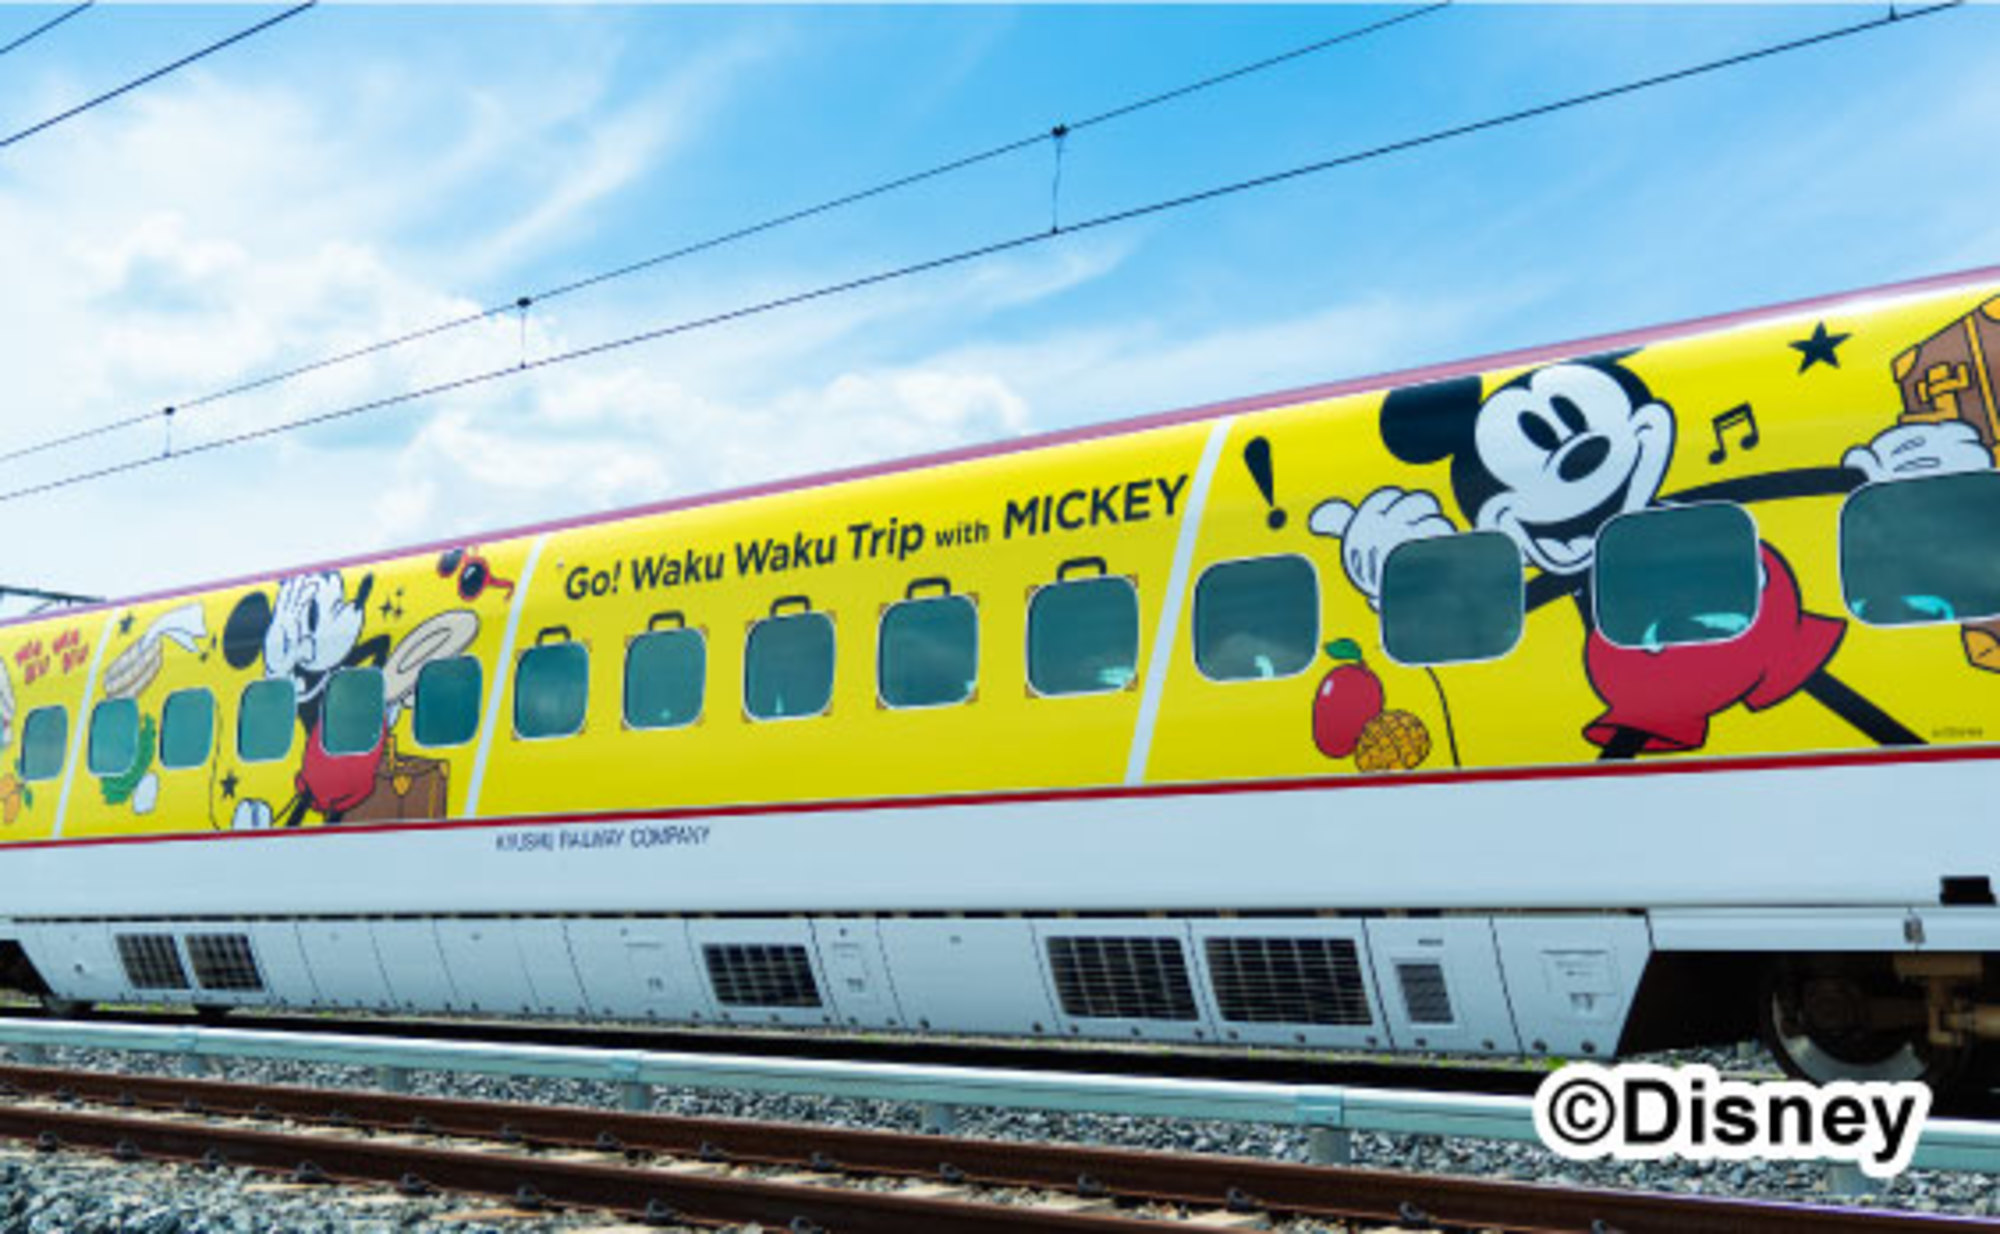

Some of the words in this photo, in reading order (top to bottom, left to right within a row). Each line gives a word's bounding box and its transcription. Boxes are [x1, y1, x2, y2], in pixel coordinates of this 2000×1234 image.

[564, 560, 622, 600] Go!
[631, 548, 724, 589] Waku
[734, 532, 837, 575] Waku
[848, 517, 924, 561] Trip
[935, 520, 990, 549] with
[1003, 474, 1188, 539] MICKEY
